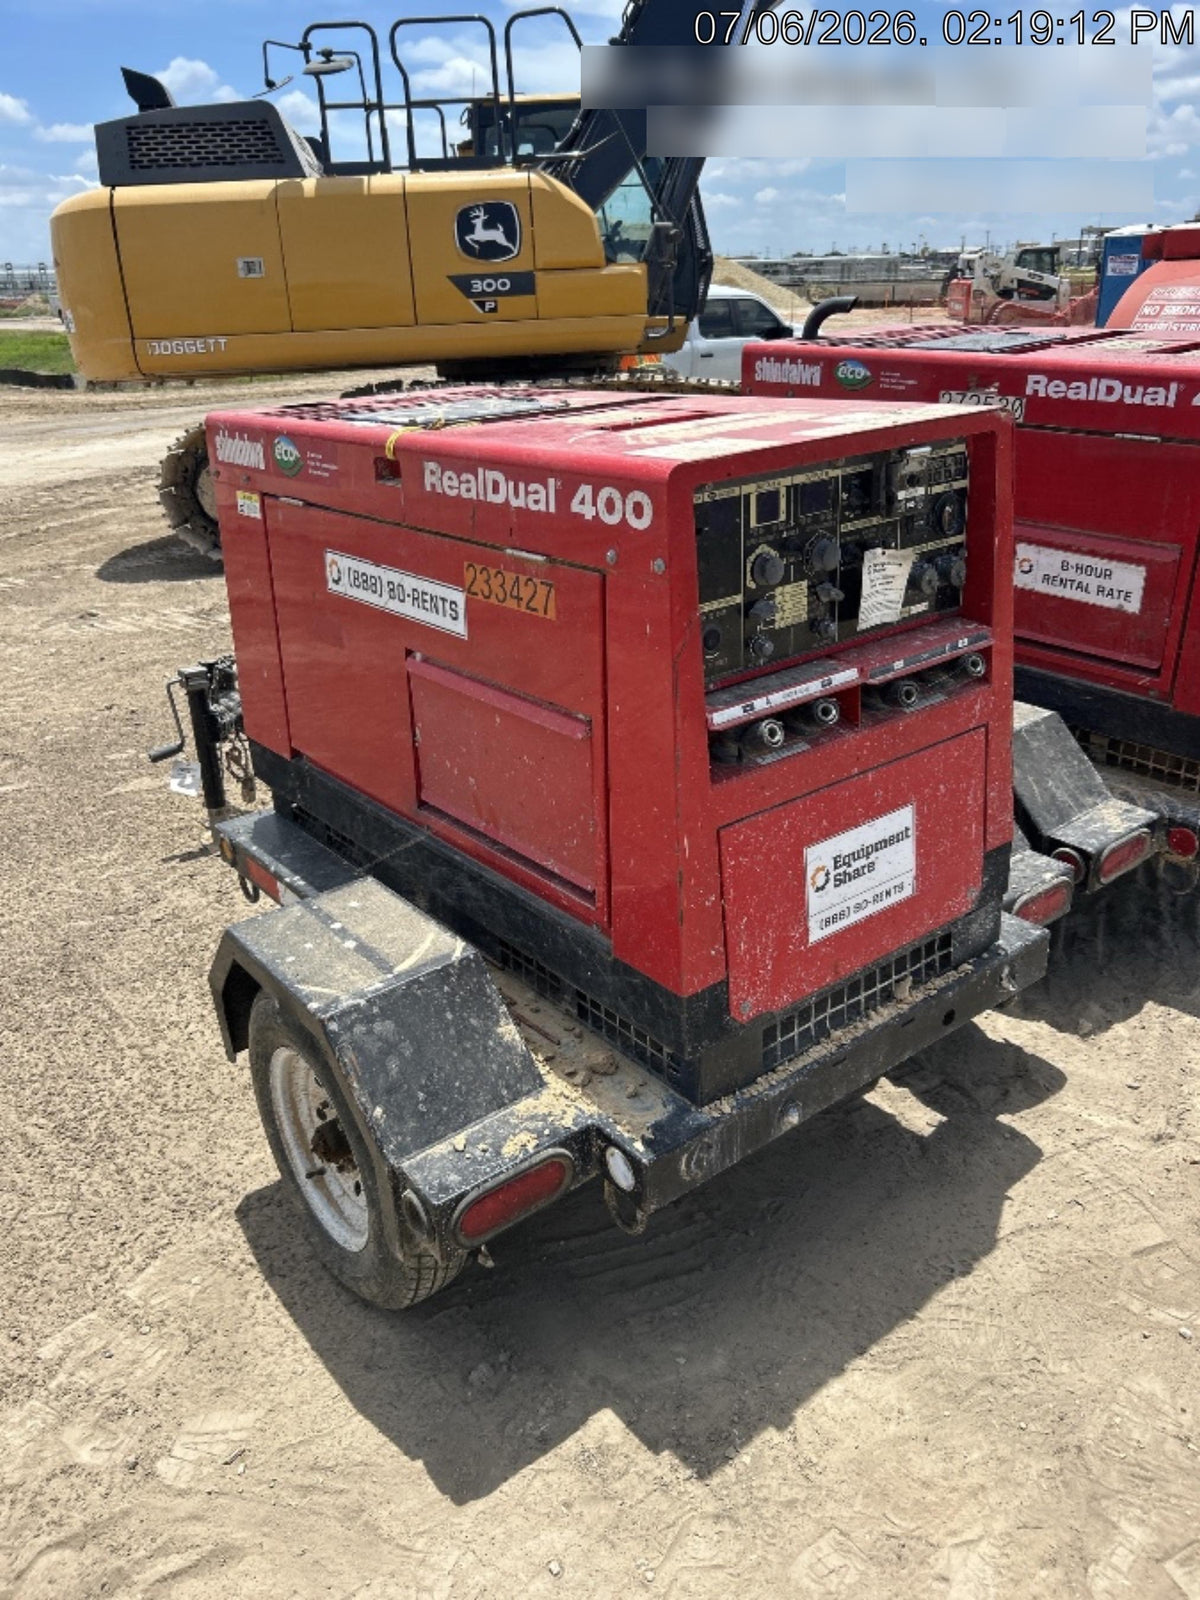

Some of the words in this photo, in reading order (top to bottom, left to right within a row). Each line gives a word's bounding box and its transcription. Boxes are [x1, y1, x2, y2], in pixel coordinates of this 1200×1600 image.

[470, 278, 511, 292] 300
[484, 301, 496, 312] P
[147, 338, 228, 356] DOGGETT
[755, 356, 822, 387] shindaiwa
[837, 362, 866, 380] eco
[570, 483, 653, 531] 400
[348, 566, 383, 598] (888)
[387, 580, 459, 622] 80-RENTS
[466, 562, 554, 616] 233427
[1041, 573, 1091, 595] RENTAL
[1096, 584, 1133, 604] RATE
[832, 826, 911, 871] Equipment
[833, 861, 876, 888] Share
